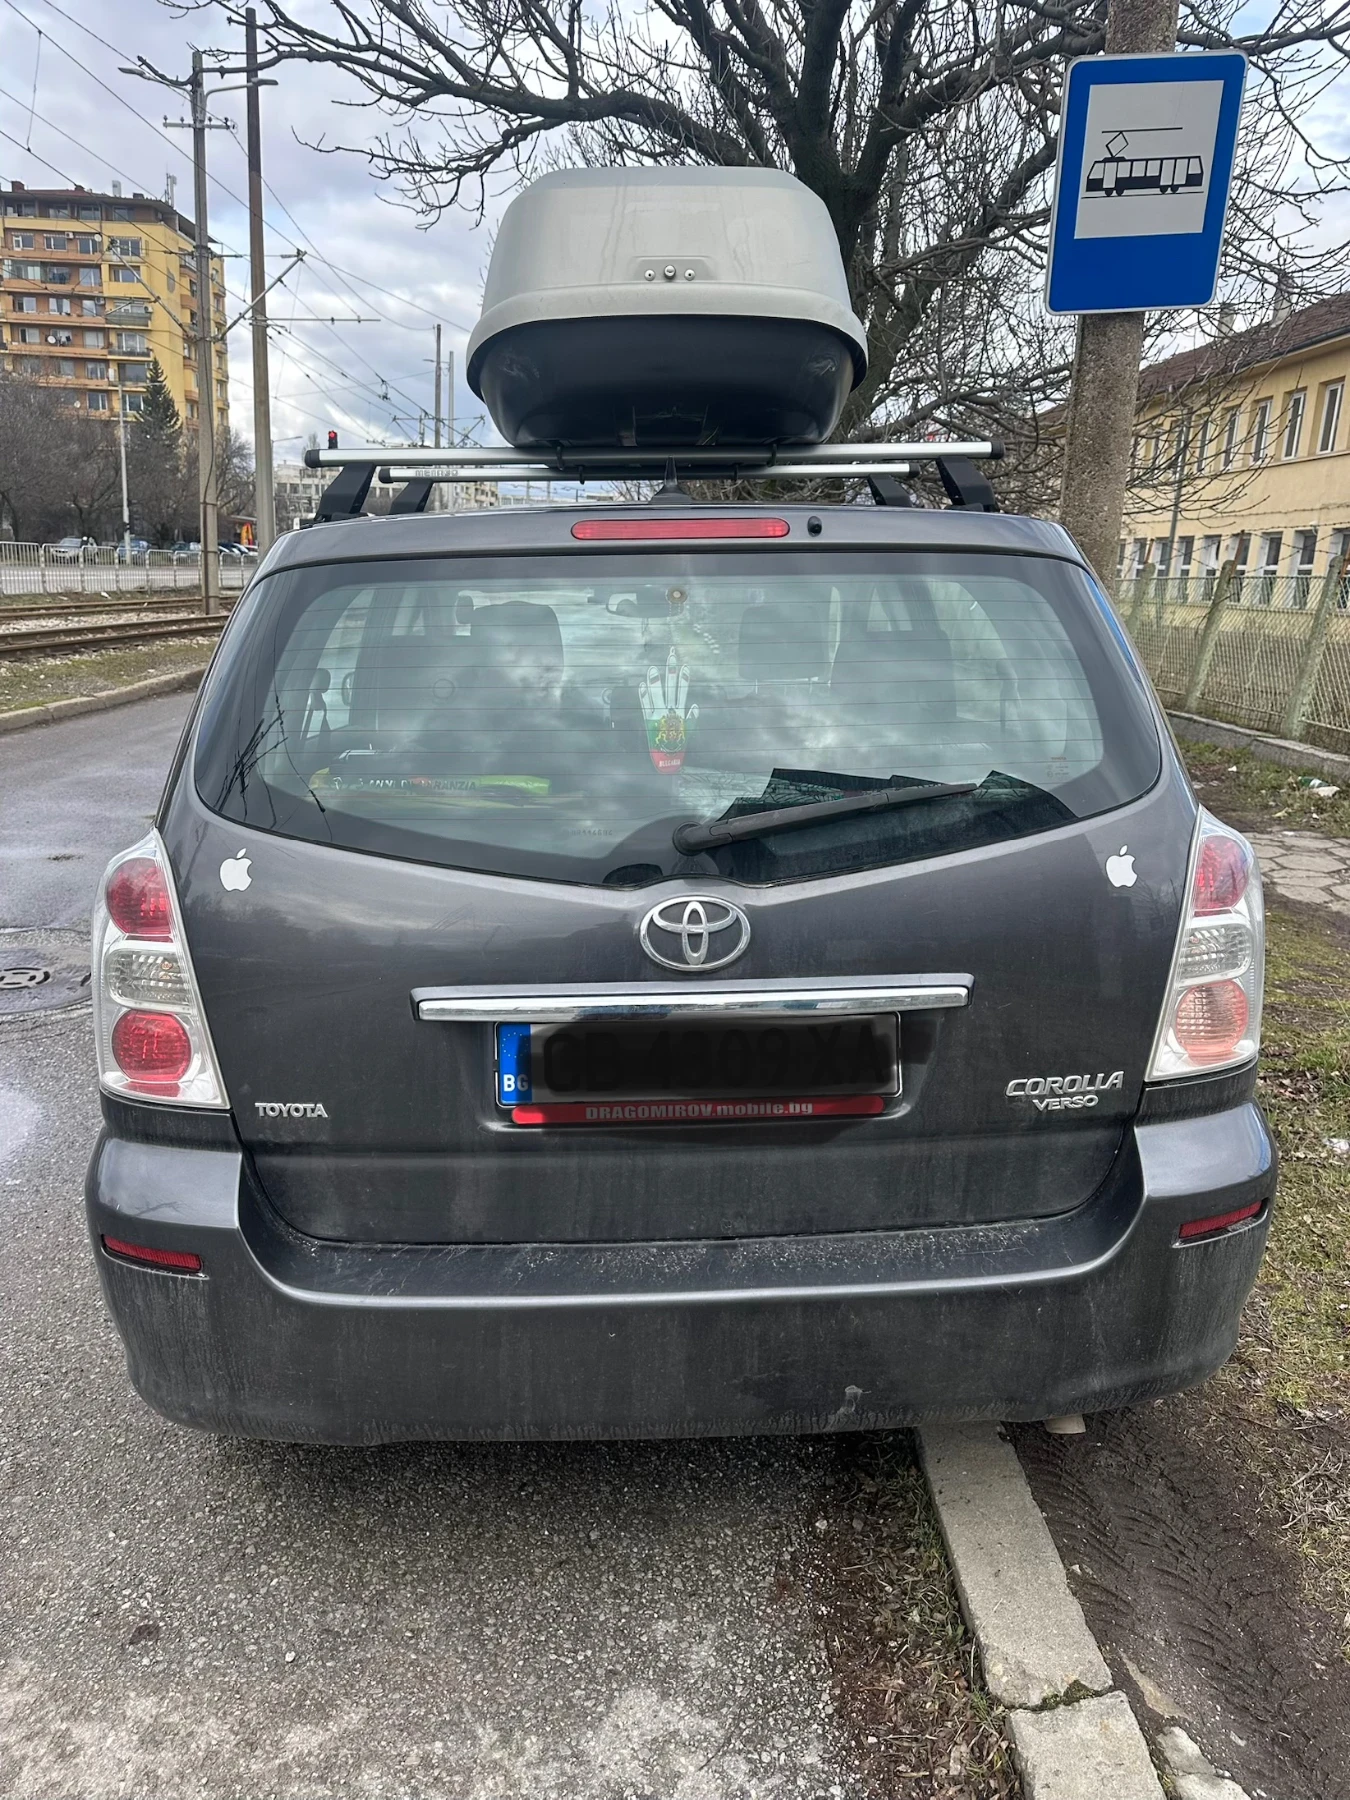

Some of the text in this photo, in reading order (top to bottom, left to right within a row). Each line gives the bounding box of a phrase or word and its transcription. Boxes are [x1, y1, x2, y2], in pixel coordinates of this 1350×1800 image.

[503, 1073, 529, 1092] BG
[1005, 1070, 1125, 1097] COROLLA
[254, 1102, 329, 1118] TOYOTA
[585, 1101, 814, 1120] DRAGOMIROV.mobile.bg
[1032, 1094, 1099, 1112] VERSO
